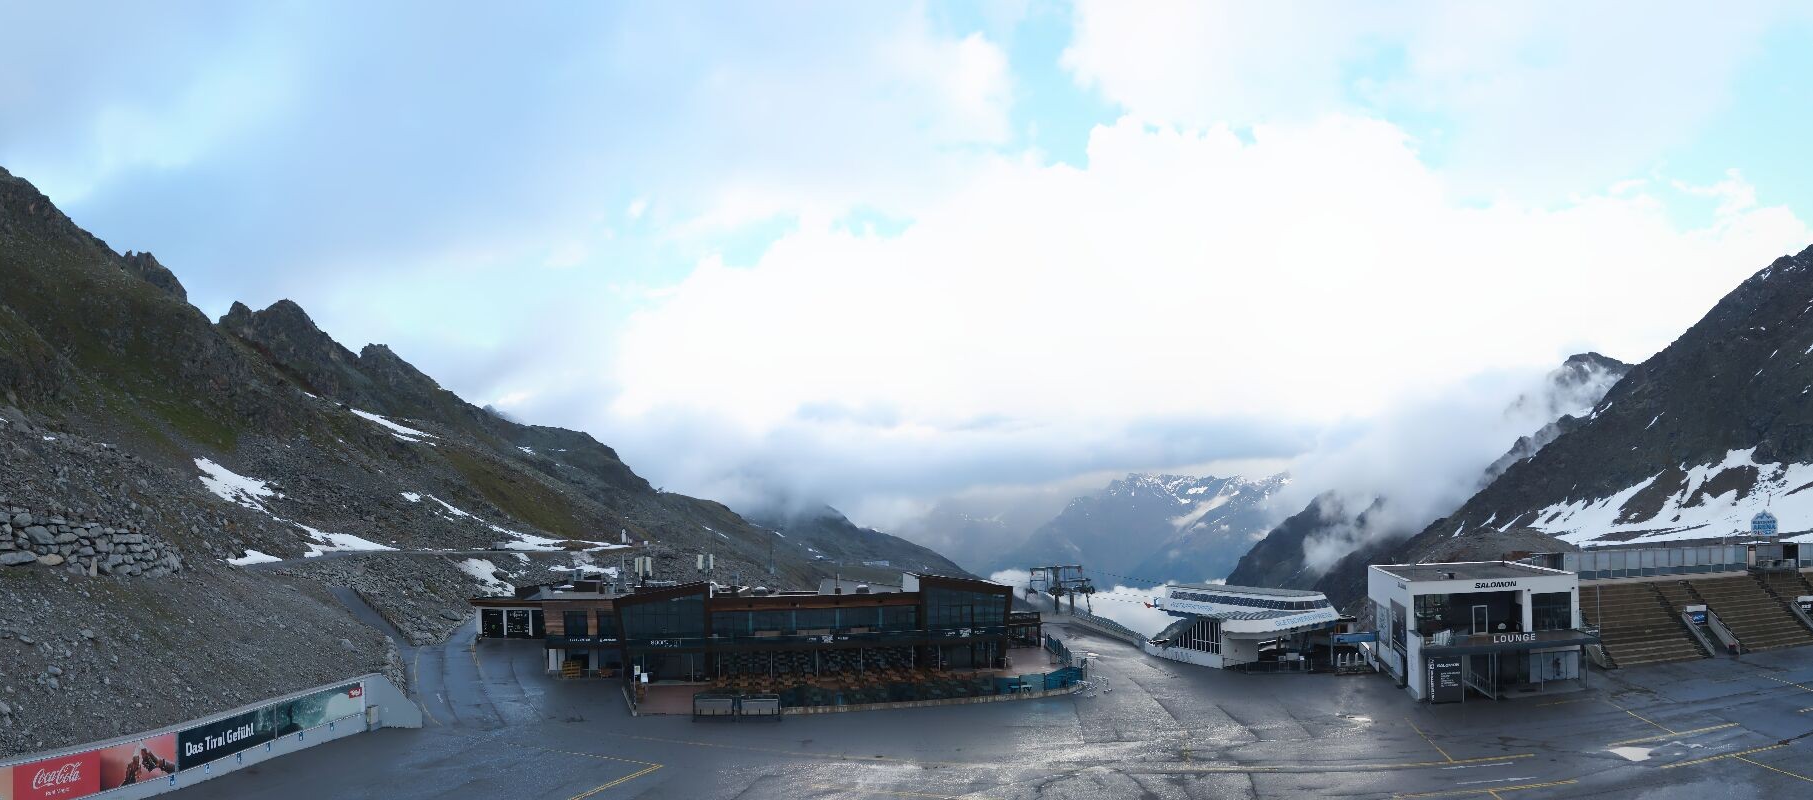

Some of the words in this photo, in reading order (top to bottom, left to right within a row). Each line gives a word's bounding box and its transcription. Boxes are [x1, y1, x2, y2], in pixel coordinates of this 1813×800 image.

[1474, 581, 1517, 589] SALOMON
[1493, 633, 1536, 644] LOUNGE
[185, 741, 204, 757] Das
[204, 732, 225, 751] Tirol
[226, 722, 255, 744] Gefühl
